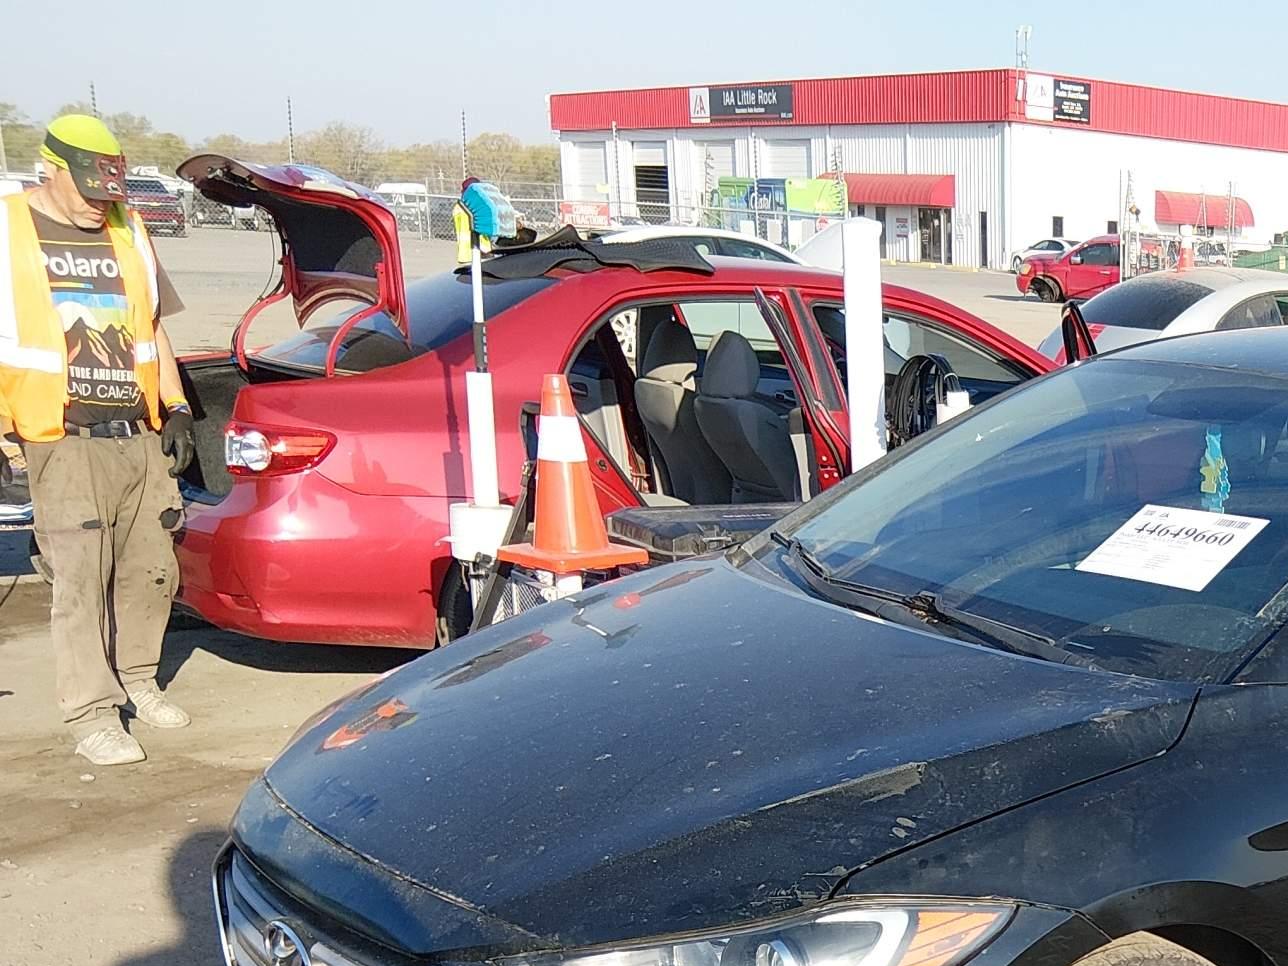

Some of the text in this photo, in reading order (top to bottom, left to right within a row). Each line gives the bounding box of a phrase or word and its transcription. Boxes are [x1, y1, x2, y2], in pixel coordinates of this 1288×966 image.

[722, 88, 778, 106] IAA Little Rock
[1134, 521, 1235, 546] 44649660
